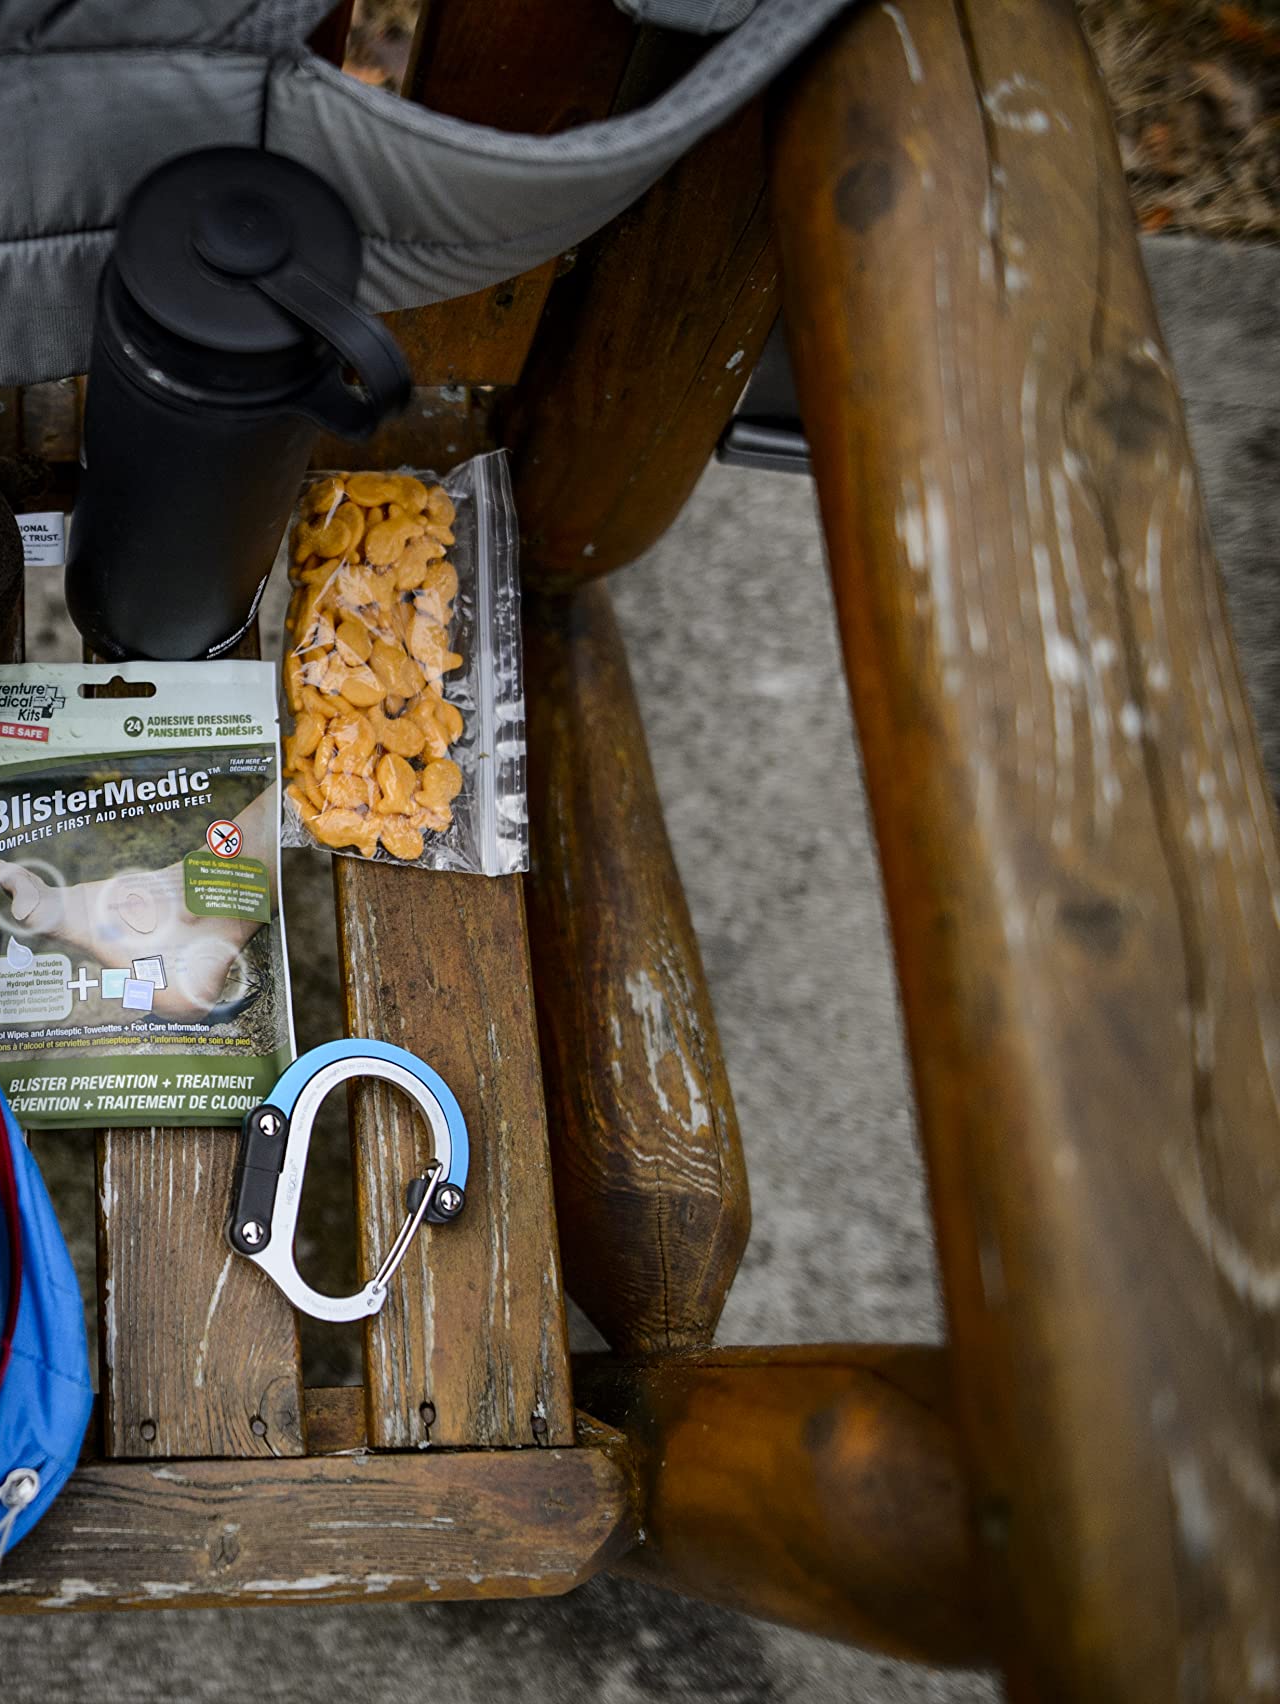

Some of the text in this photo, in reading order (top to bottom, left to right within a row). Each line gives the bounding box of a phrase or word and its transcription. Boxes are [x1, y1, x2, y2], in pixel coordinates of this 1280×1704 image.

[20, 524, 49, 533] IONAL
[29, 533, 59, 542] TRUST
[17, 708, 41, 722] Kits
[147, 714, 252, 726] ADHESIVE DRESSINGS
[1, 725, 43, 739] BE SAFE
[126, 720, 141, 732] 24
[147, 725, 264, 738] PANSEMENTS ADHÉSIFS
[57, 815, 91, 833] FIRST
[95, 810, 117, 823] AID
[121, 805, 145, 819] FOR
[148, 799, 180, 813] YOUR
[184, 793, 213, 808] FEET
[36, 959, 63, 968] Includes
[32, 968, 64, 978] Multi-day
[6, 978, 64, 989] Hydrogel Dressing
[6, 1030, 29, 1041] Wipes
[30, 1028, 45, 1038] and
[46, 1027, 82, 1038] Antiseptic
[84, 1024, 122, 1034] Towelettes
[131, 1022, 148, 1032] Foot
[148, 1022, 166, 1032] Care
[167, 1022, 210, 1032] Information
[19, 1041, 45, 1051] l'alcool
[46, 1041, 54, 1049] et
[55, 1038, 90, 1048] serviettes
[91, 1035, 141, 1048] antiseptiques
[150, 1034, 197, 1045] l'information
[197, 1036, 207, 1044] de
[208, 1035, 224, 1045] soin
[224, 1036, 234, 1046] de
[235, 1036, 252, 1047] pied
[9, 1076, 68, 1093] BLISTER
[70, 1074, 159, 1091] PREVENTION
[175, 1074, 255, 1090] TREATMENT
[6, 1095, 81, 1112] ÉVENTION
[96, 1094, 187, 1110] TRAITEMENT
[188, 1095, 209, 1110] DE
